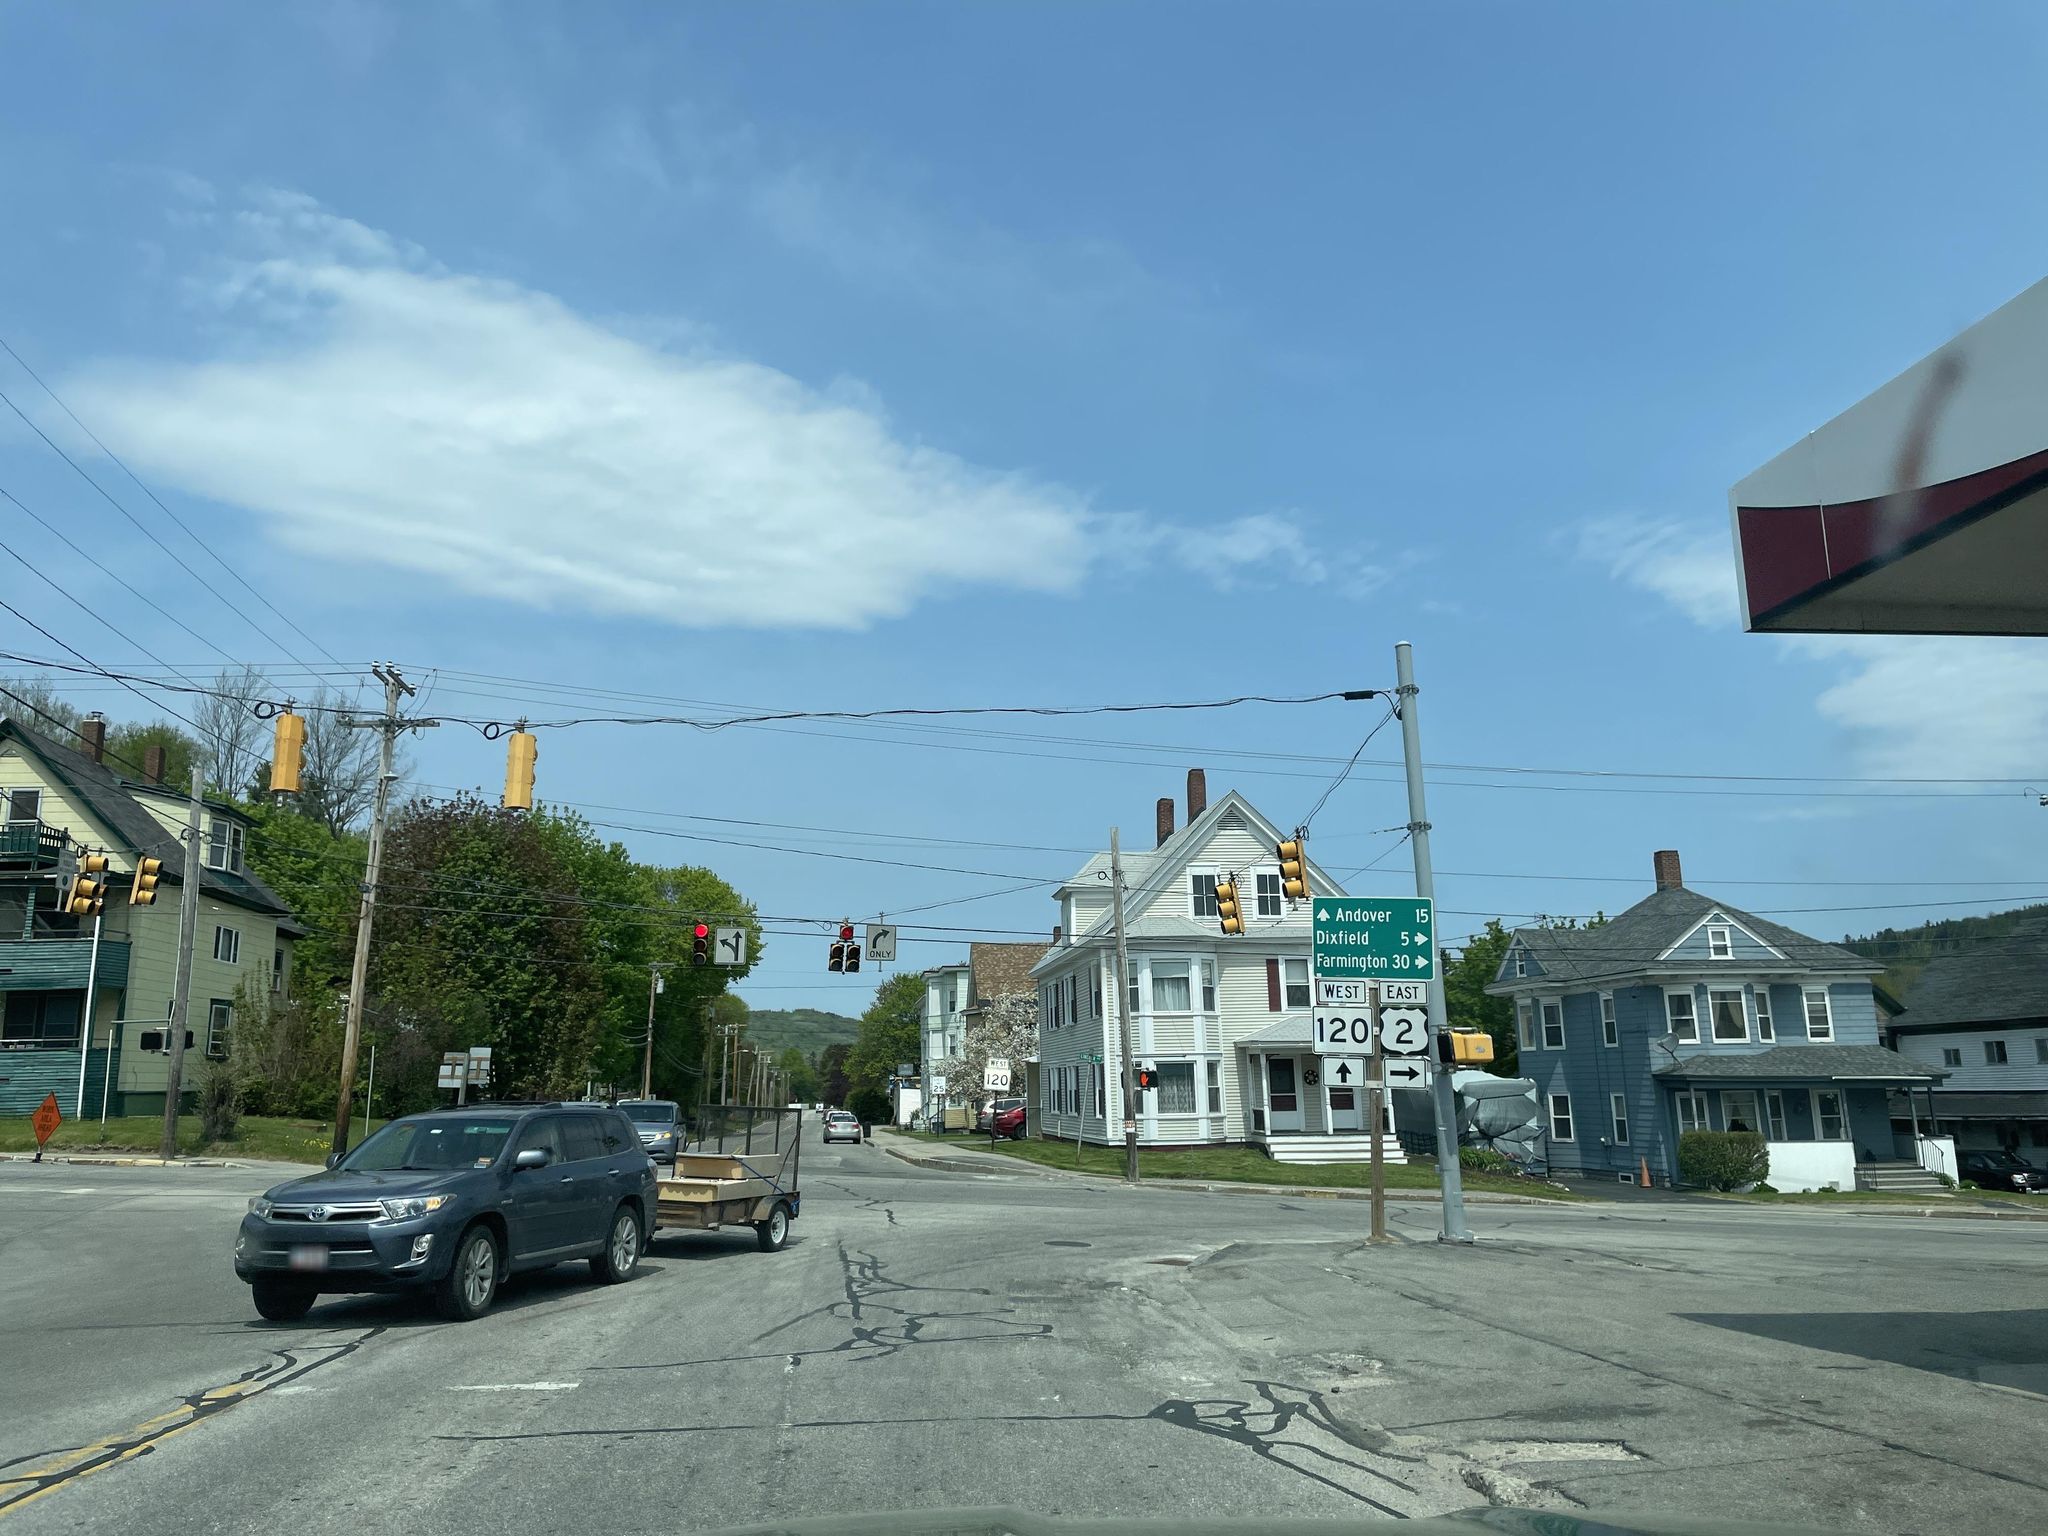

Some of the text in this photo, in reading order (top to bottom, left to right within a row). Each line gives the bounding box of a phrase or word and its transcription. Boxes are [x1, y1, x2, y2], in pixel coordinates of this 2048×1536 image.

[1335, 907, 1429, 923] Andover 15
[1316, 930, 1410, 946] Dixfield 5
[869, 950, 891, 958] ONLY
[1316, 953, 1410, 972] Farmington 30
[1324, 983, 1359, 998] WEST
[1387, 985, 1419, 999] EAST
[1317, 1017, 1369, 1044] 120
[1395, 1018, 1414, 1045] 2
[986, 1073, 1009, 1086] 120
[933, 1085, 944, 1093] 25
